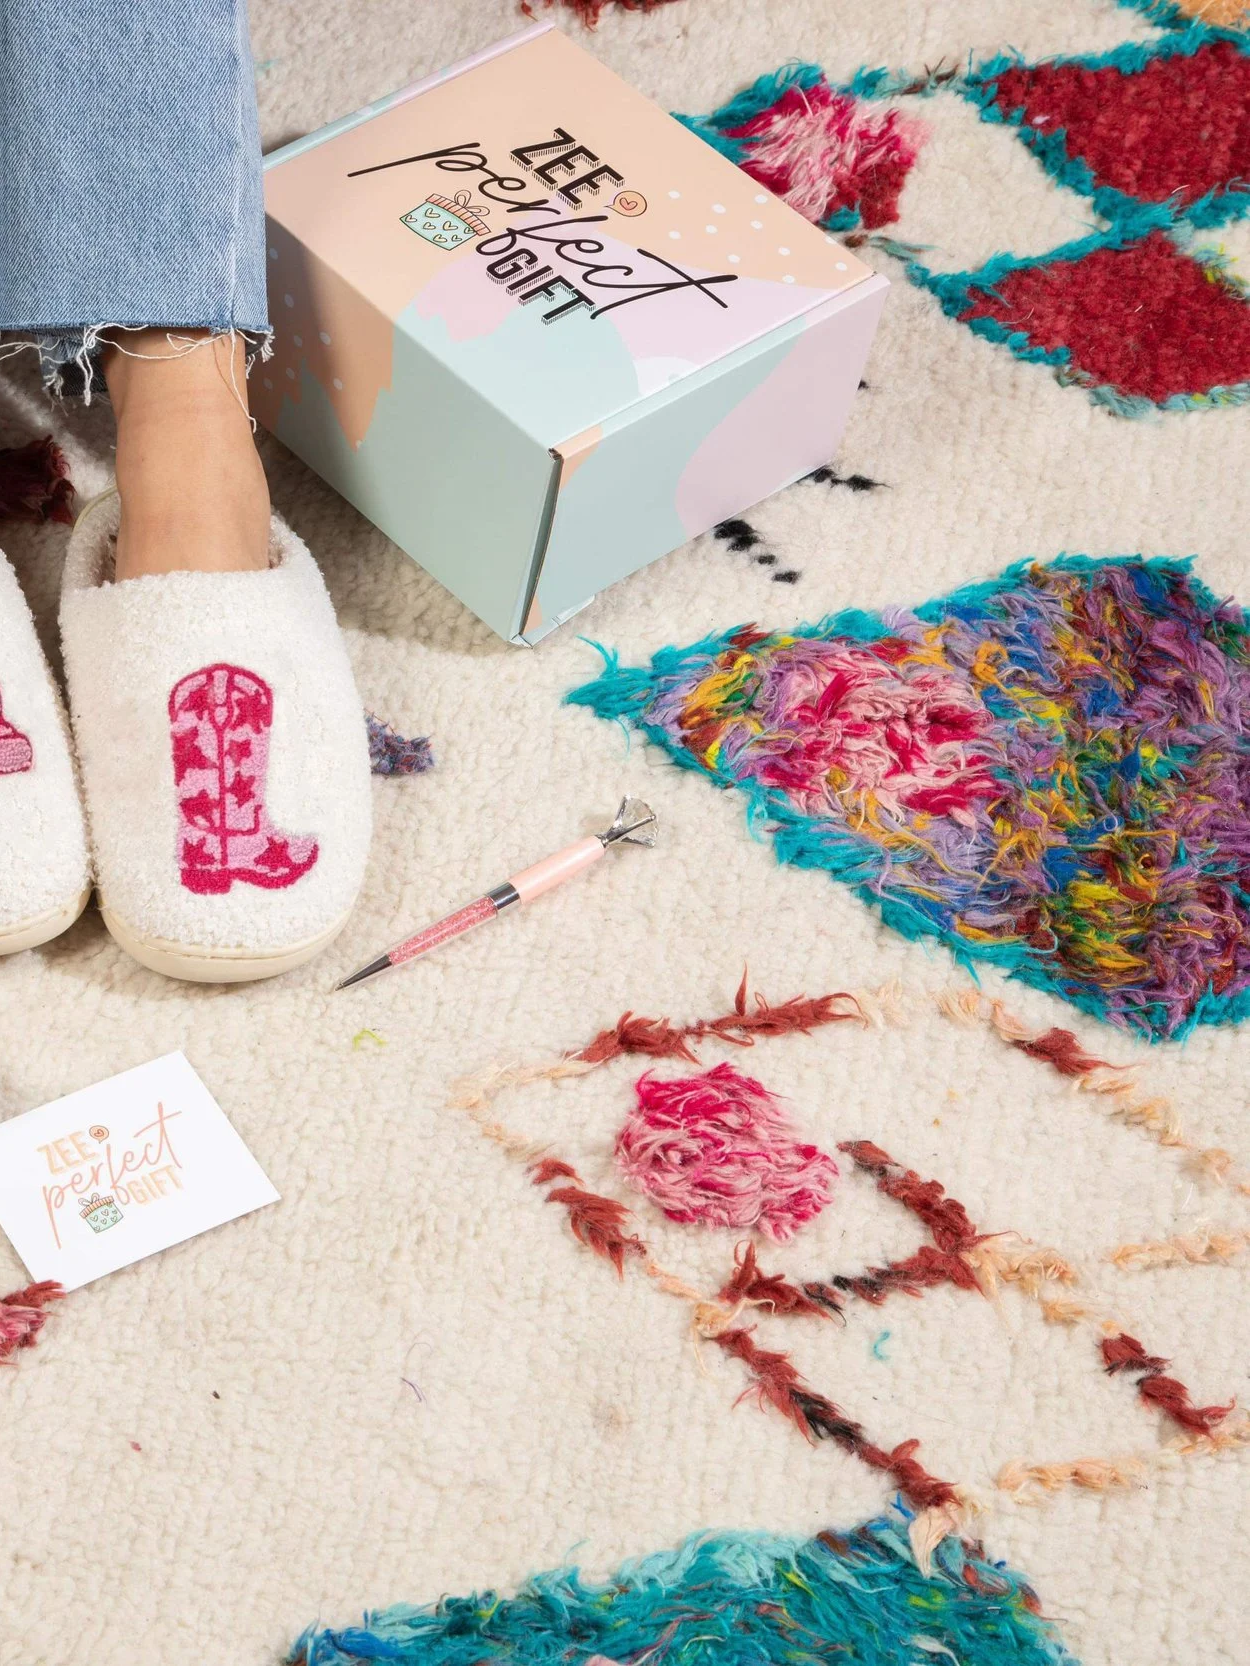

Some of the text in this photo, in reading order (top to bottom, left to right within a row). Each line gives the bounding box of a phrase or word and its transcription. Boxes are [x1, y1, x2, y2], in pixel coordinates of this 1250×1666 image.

[509, 127, 625, 210] ZEE
[347, 142, 739, 320] perfect
[485, 247, 597, 326] GIFT
[37, 1131, 98, 1176] ZEE
[42, 1101, 183, 1250] perfect
[127, 1164, 184, 1206] GIFT
